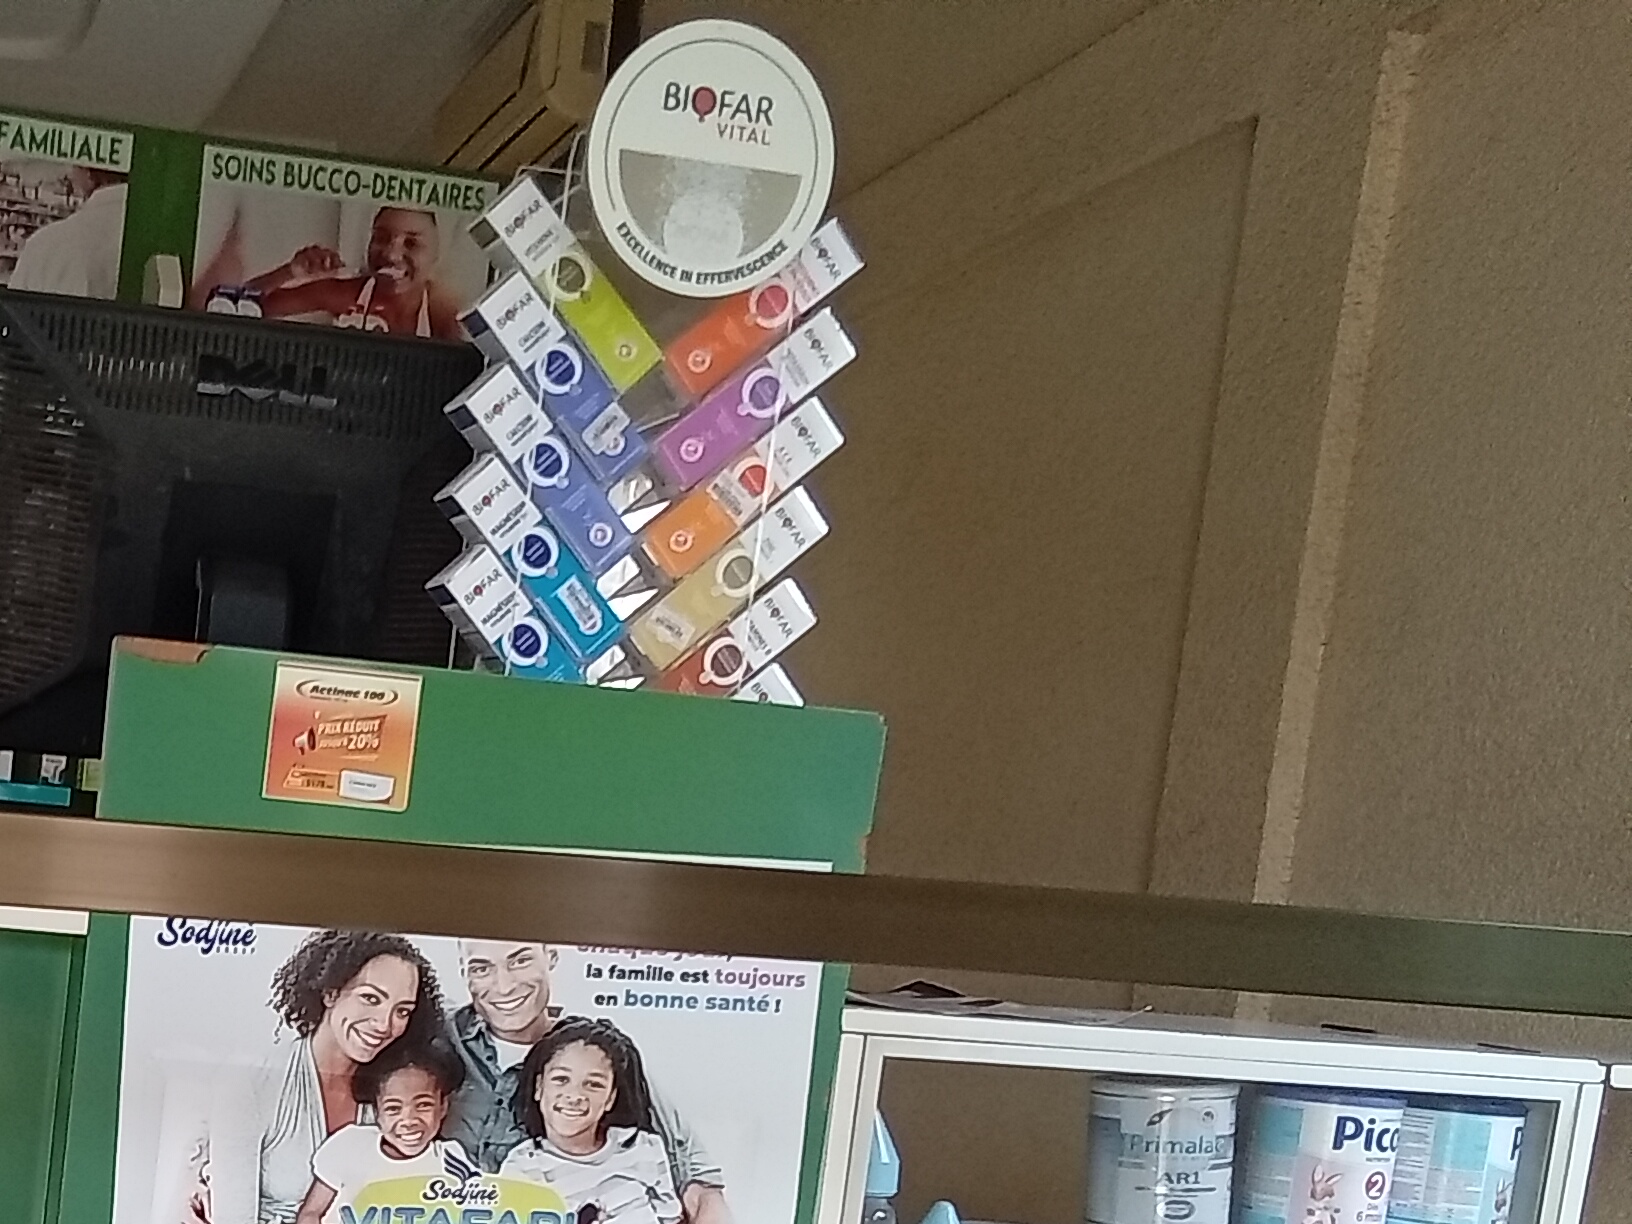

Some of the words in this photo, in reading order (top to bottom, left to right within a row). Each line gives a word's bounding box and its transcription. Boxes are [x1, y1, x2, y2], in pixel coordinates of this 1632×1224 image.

[662, 81, 774, 126] BIOFAR
[717, 122, 771, 146] VITAL
[212, 152, 276, 185] SOINS
[283, 161, 485, 211] BUCCO-DENTAIRES
[504, 199, 543, 238] BIOFAR
[615, 221, 677, 279] EXCELLENCE
[679, 269, 694, 284] IN
[694, 239, 789, 286] EFFERVESCENCE
[811, 236, 843, 281] BIOFAR
[494, 290, 535, 331] BIOFAR
[803, 327, 835, 371] BIOFAR
[482, 386, 523, 425] BIOFAR
[790, 414, 822, 457] BIOFAR
[471, 478, 511, 516] BIOFAR
[774, 507, 807, 550] BIOFAR
[463, 567, 503, 606] BIOFAR
[763, 597, 794, 640] BIOFAR
[348, 734, 380, 750] 20%
[586, 963, 603, 980] la
[608, 965, 675, 982] famille
[679, 969, 709, 984] est
[715, 968, 806, 989] toujours
[594, 993, 618, 1007] en
[624, 989, 699, 1010] bonne
[705, 994, 771, 1013] santé
[774, 999, 781, 1013] !
[1159, 1171, 1201, 1186] AR1
[1367, 1173, 1385, 1198] 2
